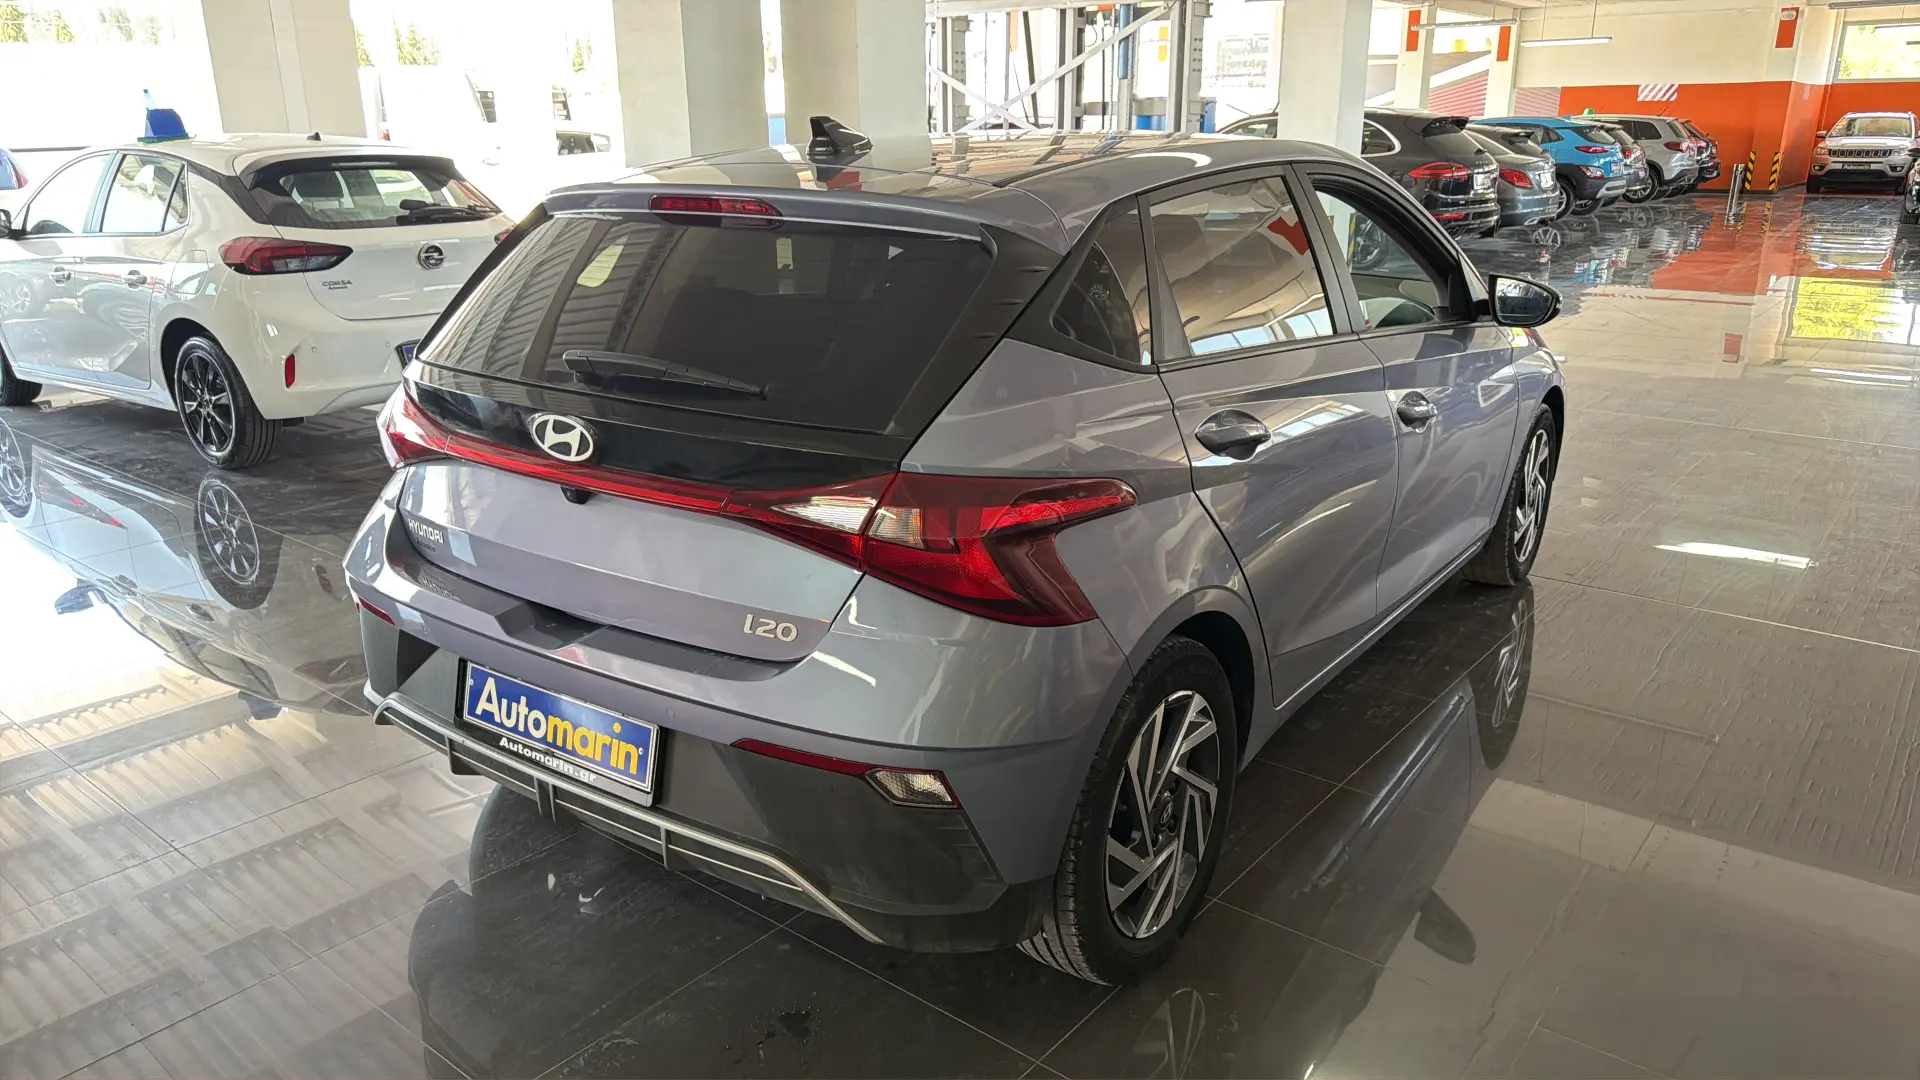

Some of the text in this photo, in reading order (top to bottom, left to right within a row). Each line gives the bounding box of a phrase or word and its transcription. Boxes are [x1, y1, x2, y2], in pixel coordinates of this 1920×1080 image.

[321, 279, 353, 287] CORSA
[408, 518, 445, 544] HYUNDAI
[475, 676, 639, 775] Automarin
[499, 736, 598, 782] Automarin.gr
